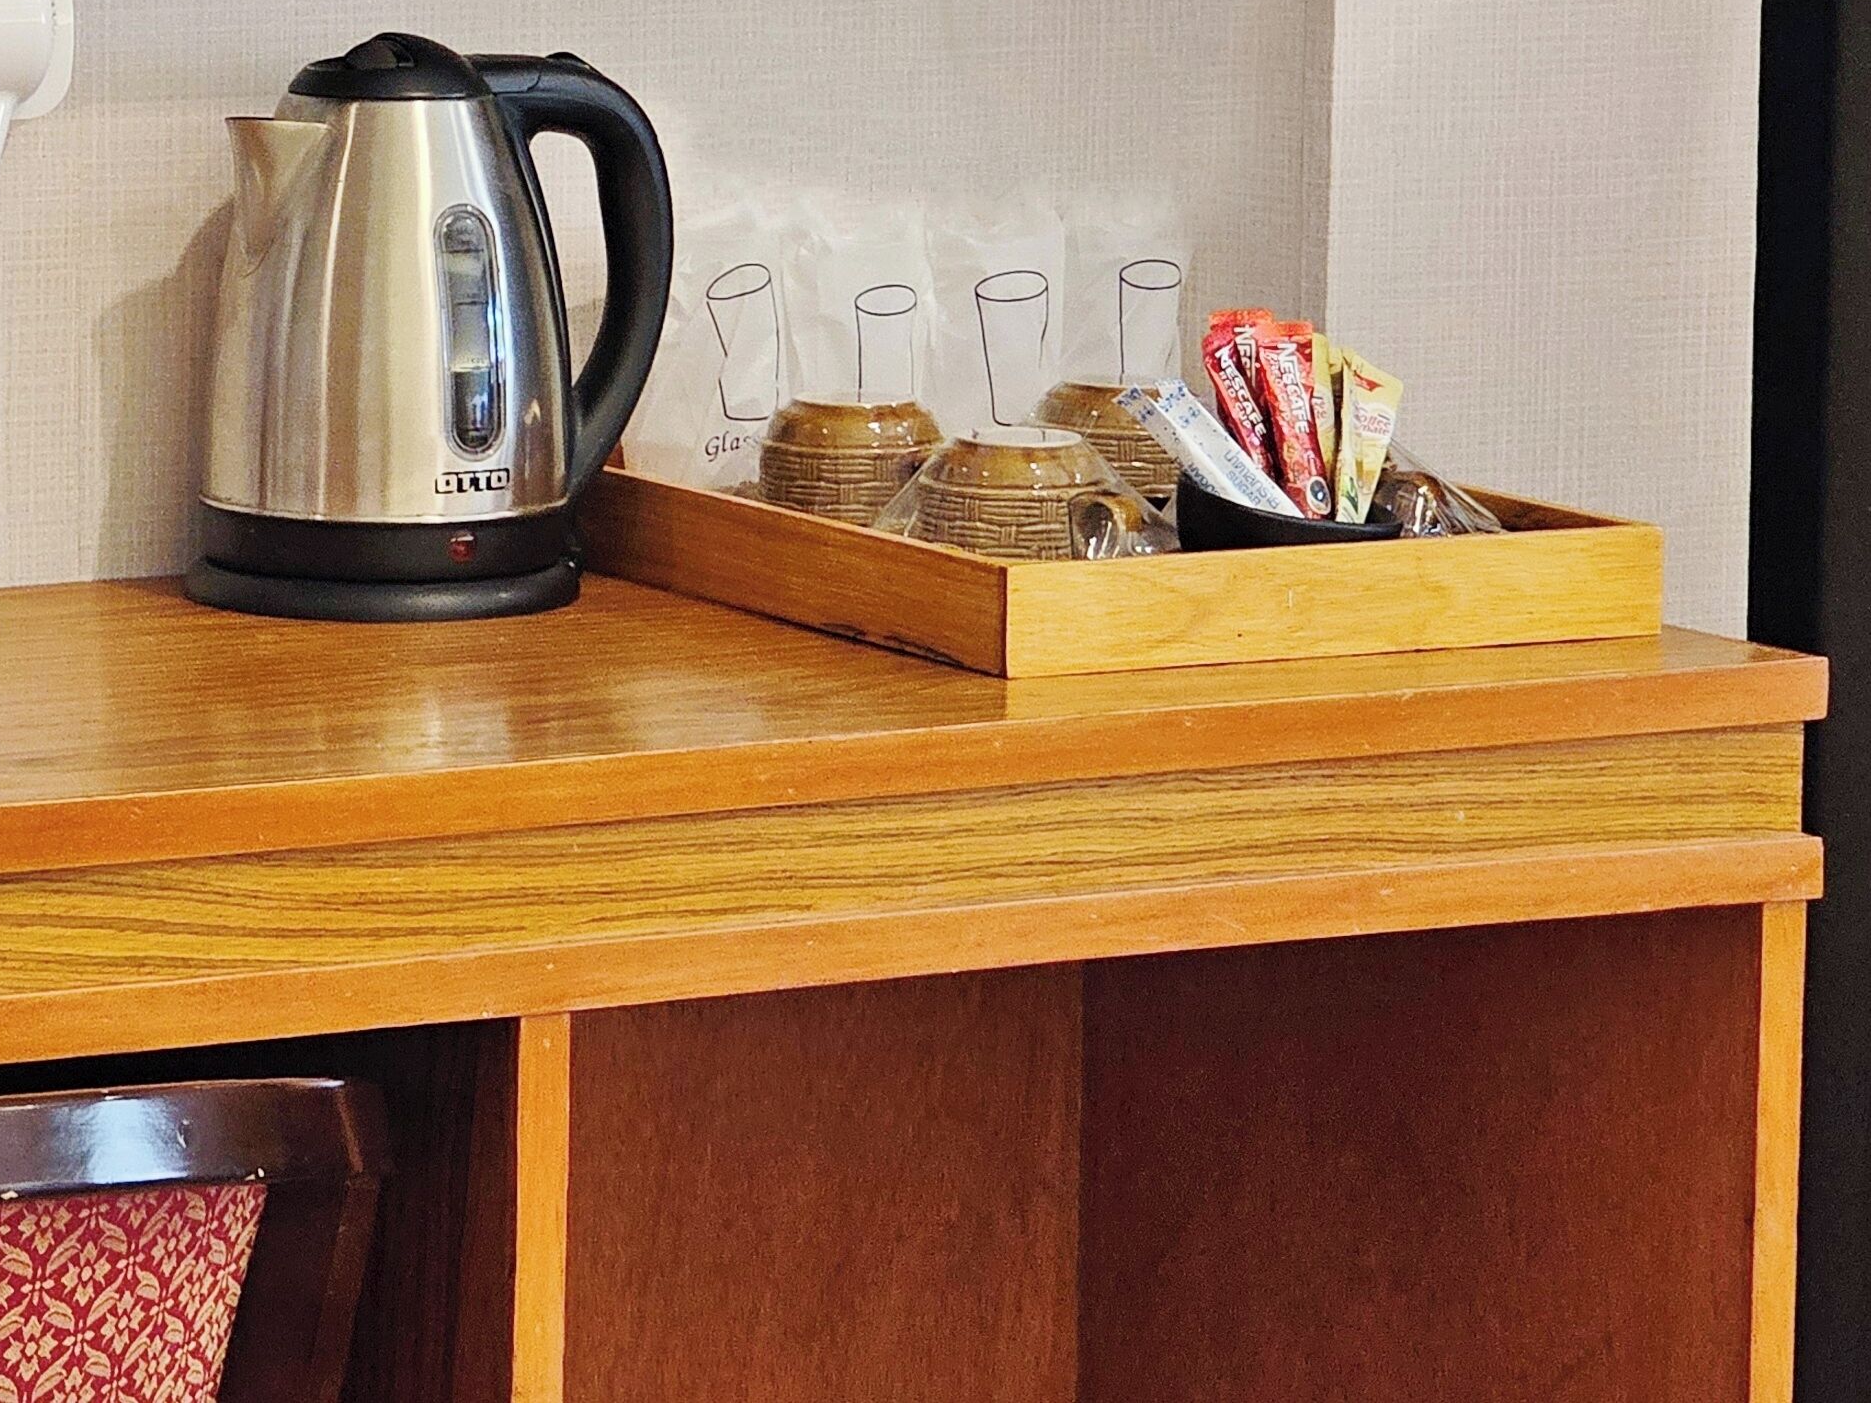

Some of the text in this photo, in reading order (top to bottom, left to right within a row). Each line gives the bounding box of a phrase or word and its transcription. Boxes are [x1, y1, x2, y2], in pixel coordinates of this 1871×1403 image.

[705, 430, 759, 463] Gla
[434, 467, 510, 494] OTTO
[1227, 470, 1262, 507] SUGAR
